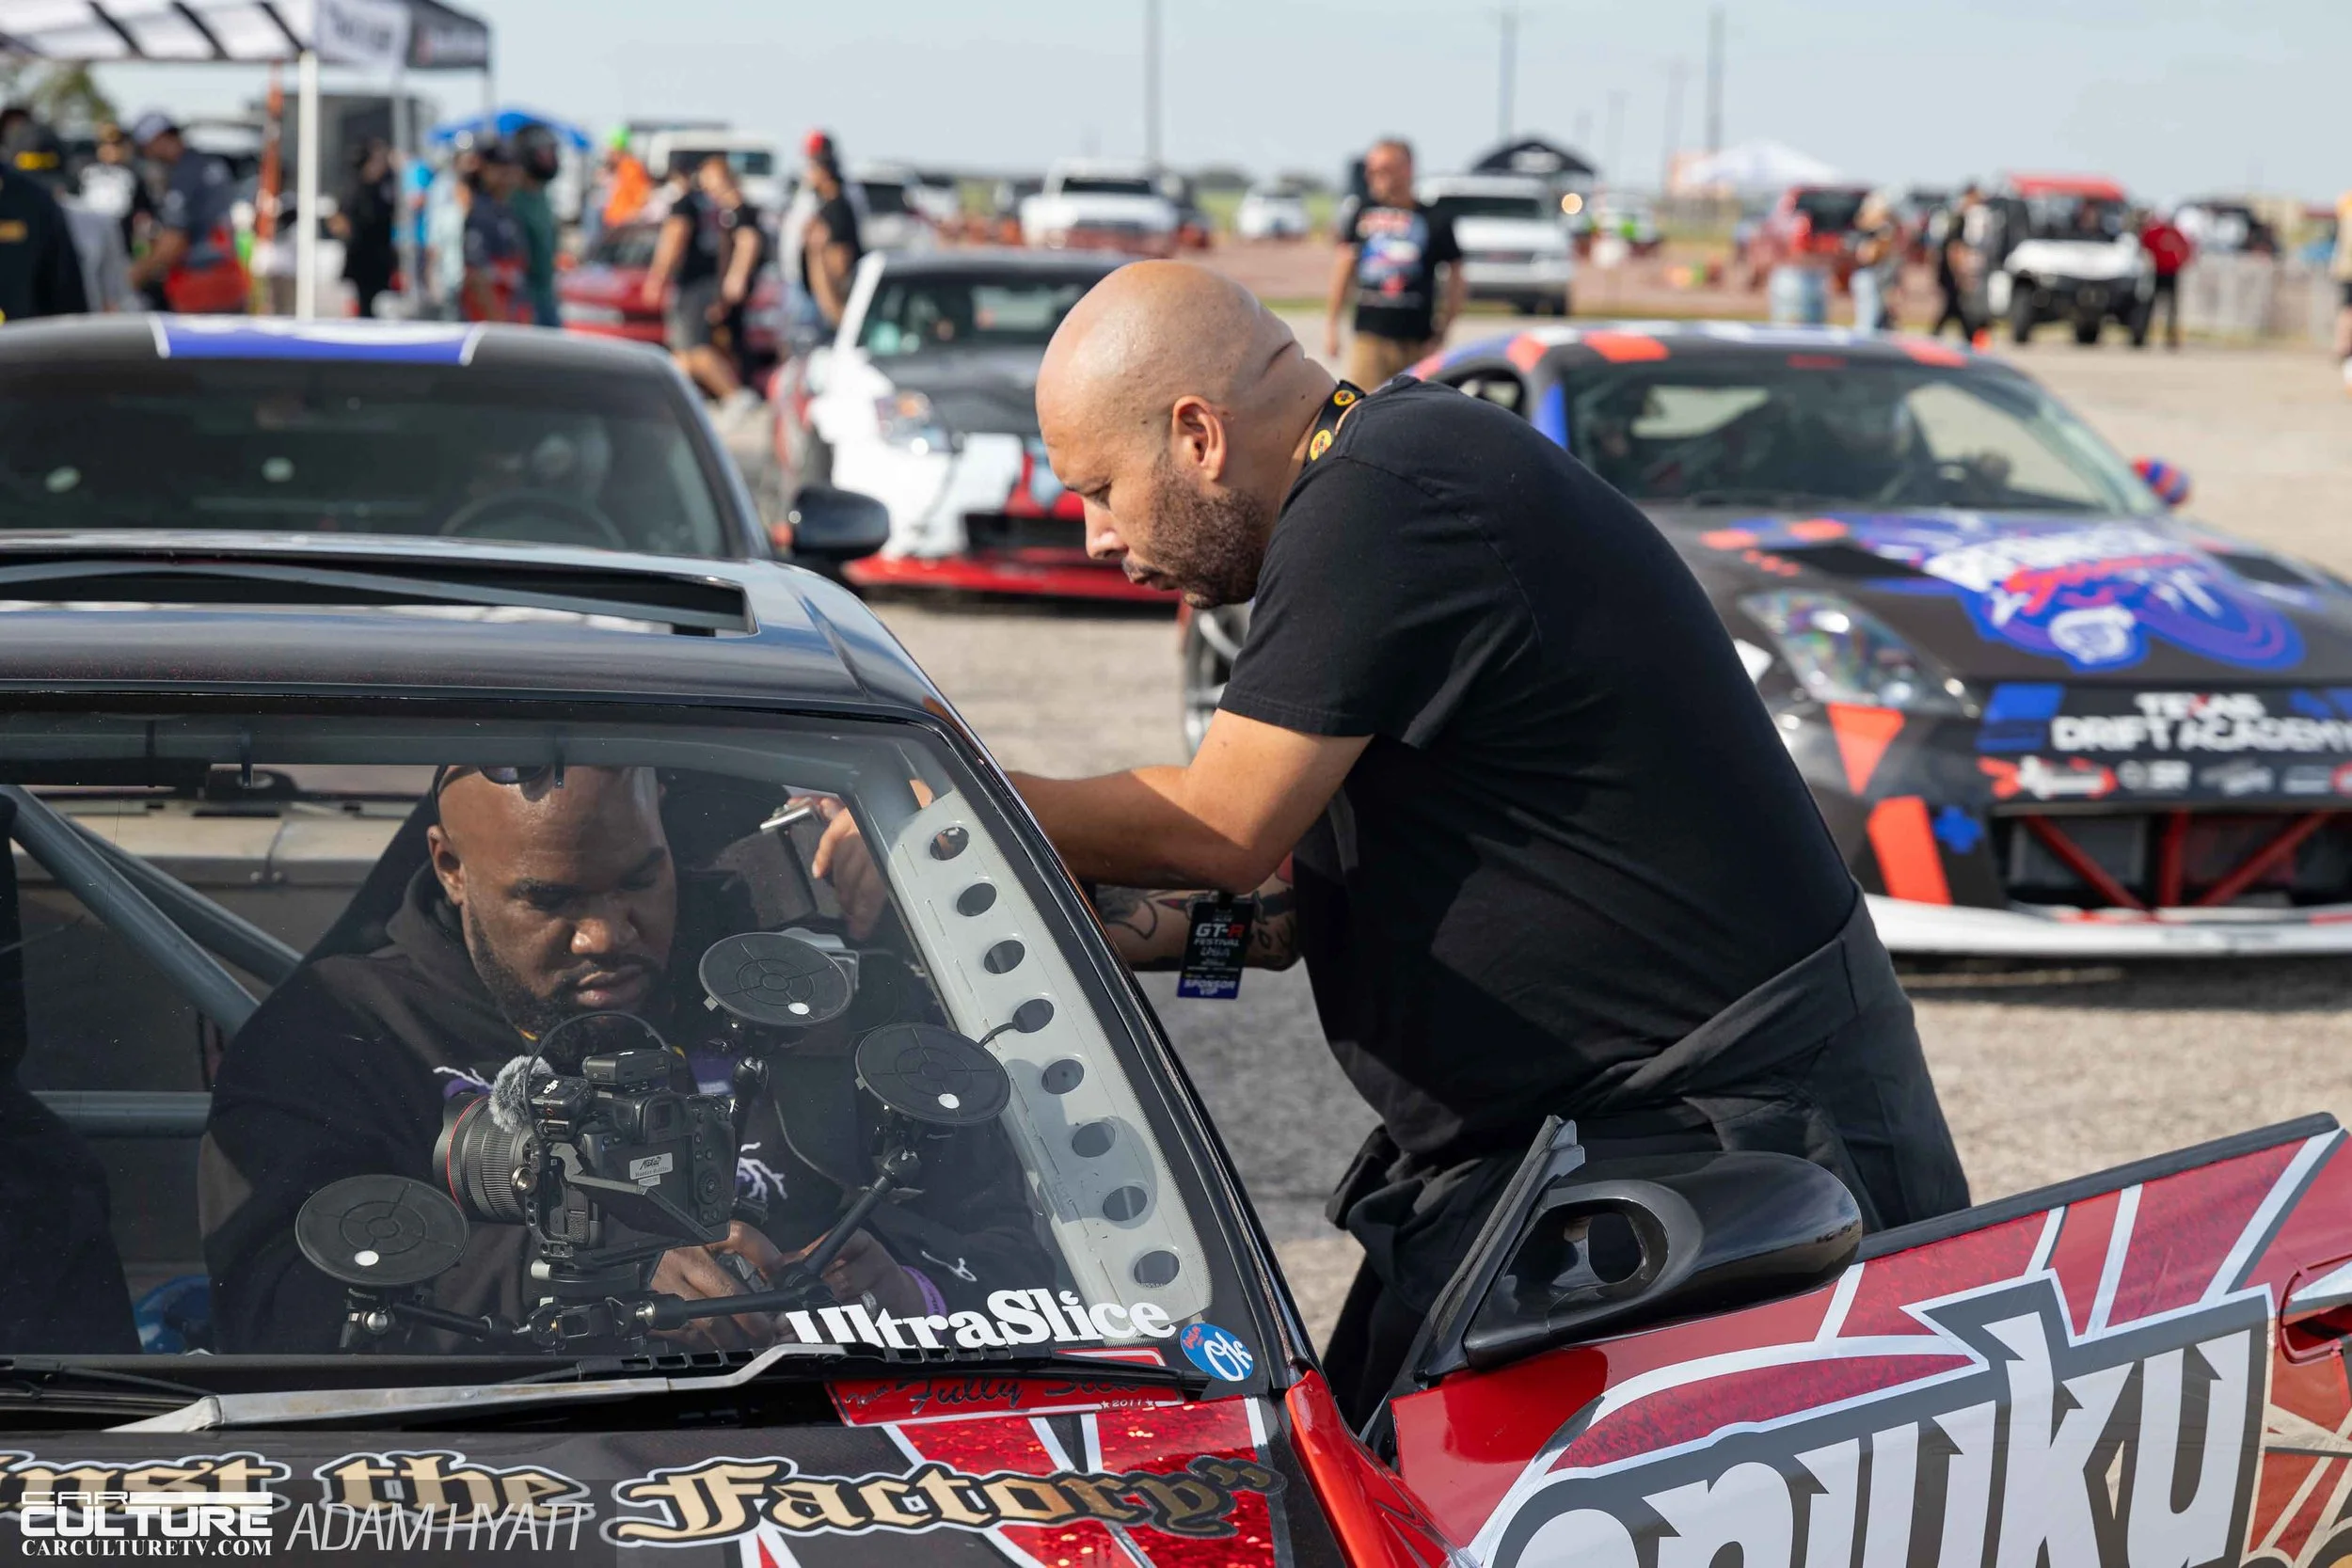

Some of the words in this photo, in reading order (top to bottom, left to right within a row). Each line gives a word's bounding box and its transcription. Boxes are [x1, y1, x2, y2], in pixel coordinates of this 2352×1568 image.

[1196, 923, 1245, 938] GT-R
[786, 1288, 1177, 1349] UltraSlice
[332, 1455, 575, 1525] the
